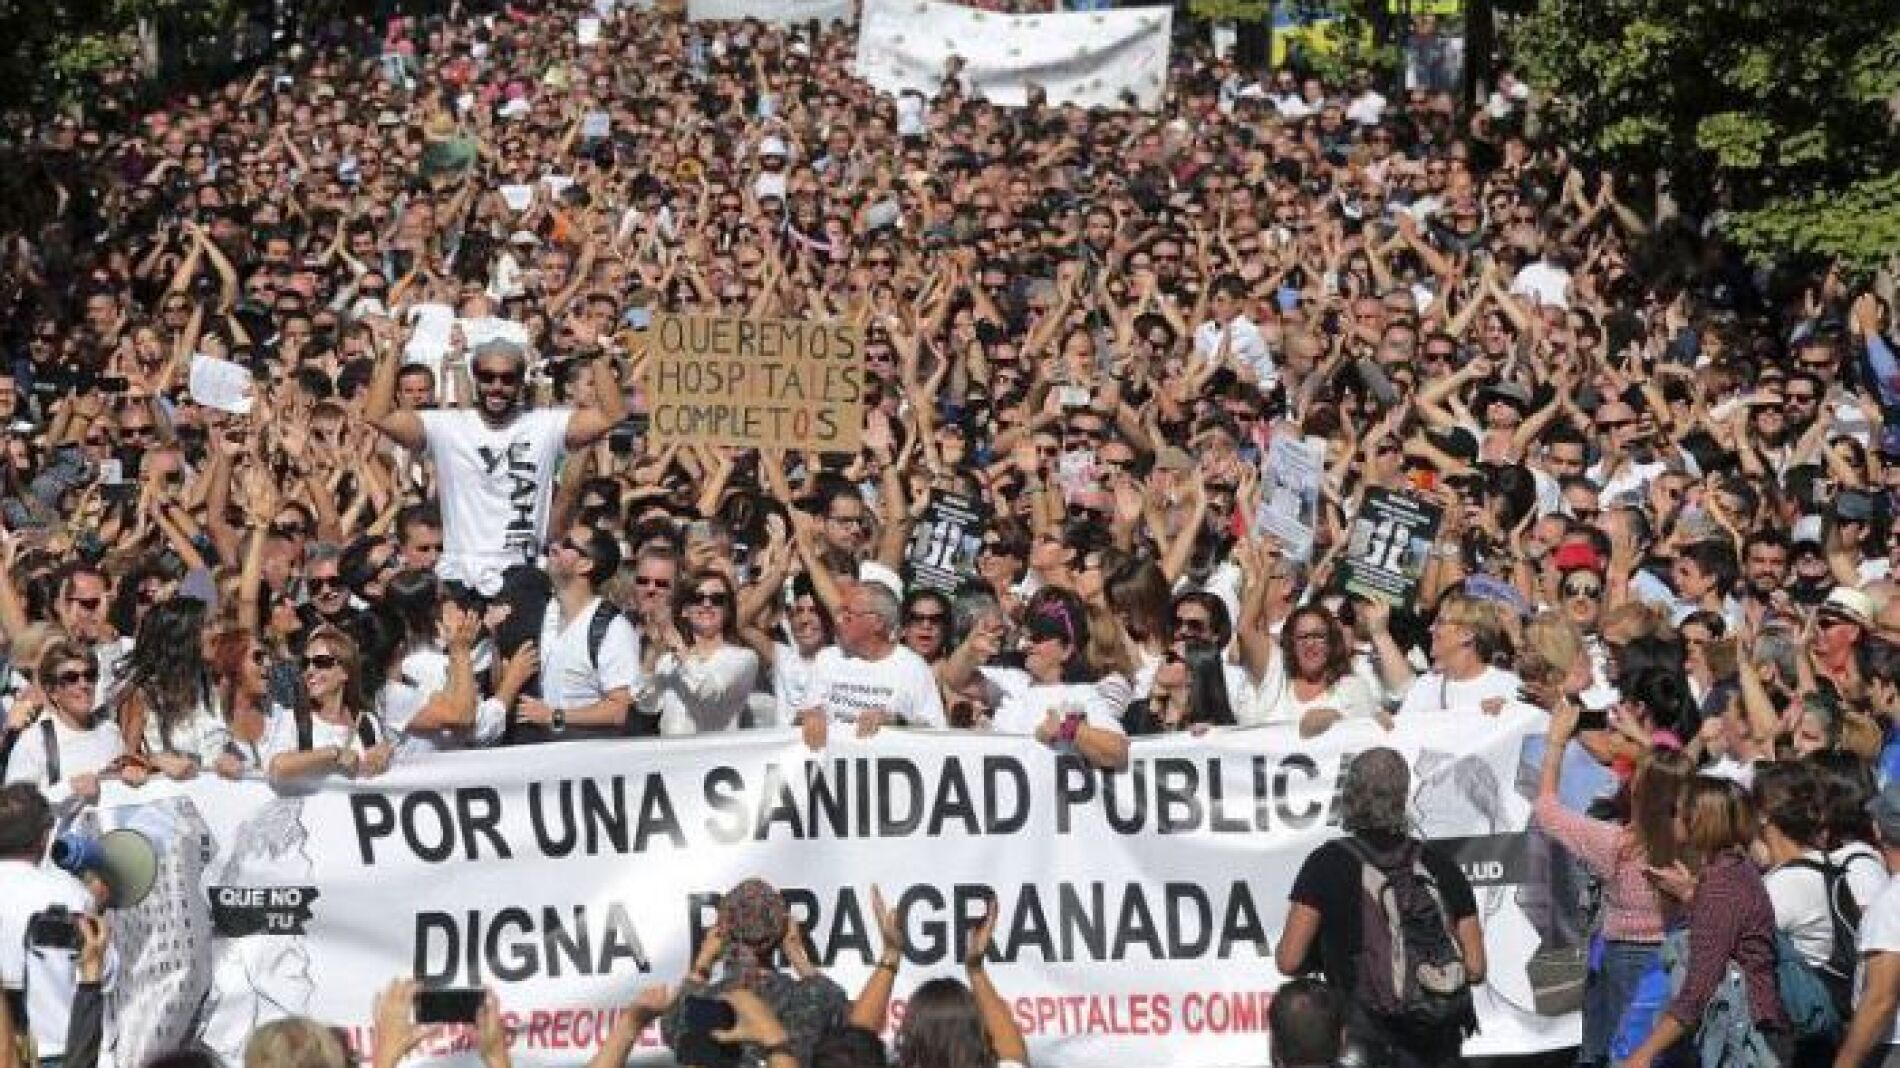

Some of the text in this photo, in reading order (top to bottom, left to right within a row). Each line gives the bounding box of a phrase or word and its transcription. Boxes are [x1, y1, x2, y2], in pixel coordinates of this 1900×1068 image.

[660, 317, 854, 359] QUEREMOS
[658, 360, 860, 402] HOSPITALES
[655, 404, 838, 441] COMPLETOS
[350, 752, 1354, 865] POR UNA SANIDAD PUBLIC
[1460, 861, 1504, 881] LUD
[219, 889, 302, 907] QUE NO
[266, 912, 294, 929] TU
[413, 880, 1270, 989] DIGNA PRA GRANADA
[1013, 993, 1172, 1036] SPITALES
